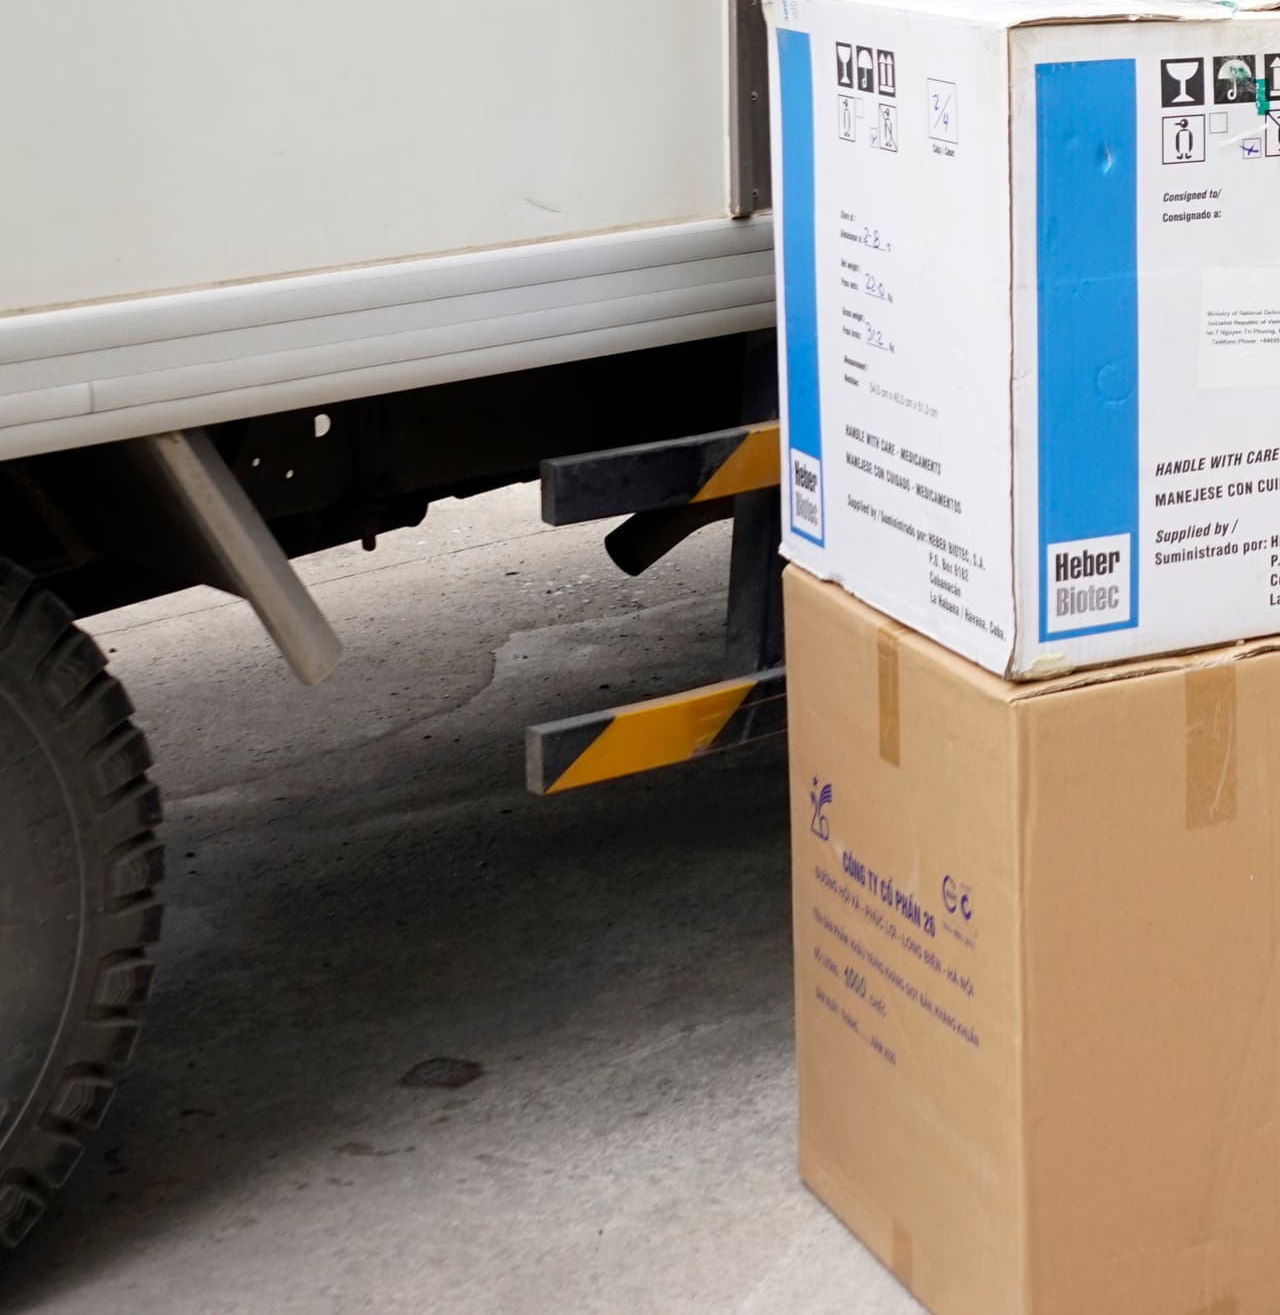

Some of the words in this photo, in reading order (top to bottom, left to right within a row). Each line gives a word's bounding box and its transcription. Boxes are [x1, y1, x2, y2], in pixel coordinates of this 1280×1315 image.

[1163, 190, 1207, 203] Consigned
[1209, 188, 1222, 201] to/
[1162, 210, 1211, 223] Consignado
[1213, 209, 1222, 218] a:
[1155, 457, 1206, 477] HANDLE
[1209, 452, 1243, 470] WITH
[1246, 447, 1280, 466] CARE
[1155, 484, 1223, 508] MANEJESE
[1227, 480, 1253, 497] CON
[1155, 524, 1212, 545] Supplied
[1213, 521, 1230, 539] by
[1055, 547, 1120, 582] Heber
[1155, 542, 1239, 566] Suministrado
[1243, 537, 1268, 556] por:
[1056, 584, 1120, 617] Biotec
[923, 911, 936, 938] 26
